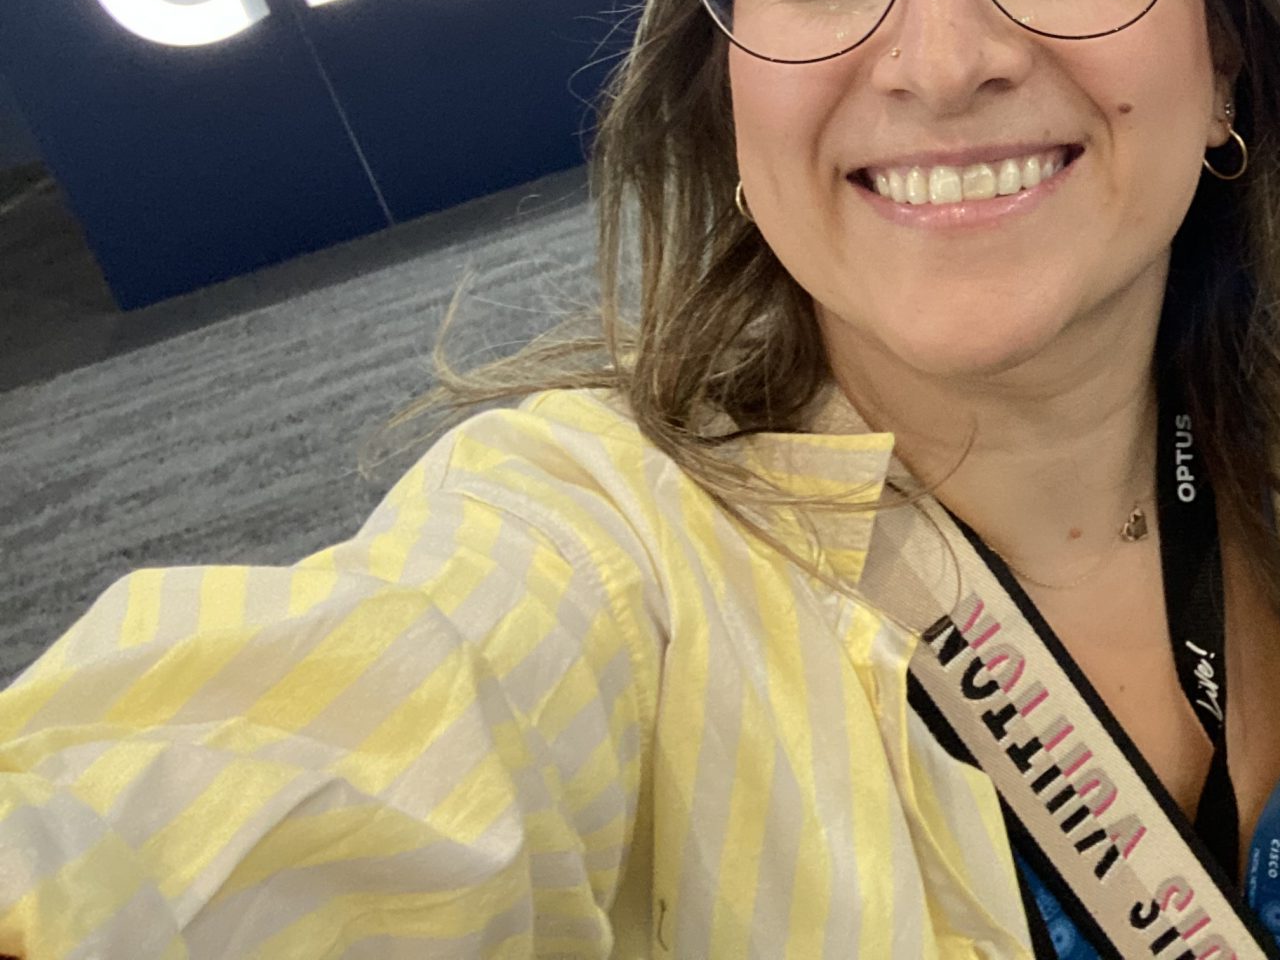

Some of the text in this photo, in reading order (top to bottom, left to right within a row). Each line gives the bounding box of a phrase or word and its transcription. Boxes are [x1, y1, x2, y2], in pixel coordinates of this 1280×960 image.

[1175, 414, 1196, 503] OPTUS
[1185, 640, 1223, 721] Live!
[920, 591, 1147, 881] VUITTON
